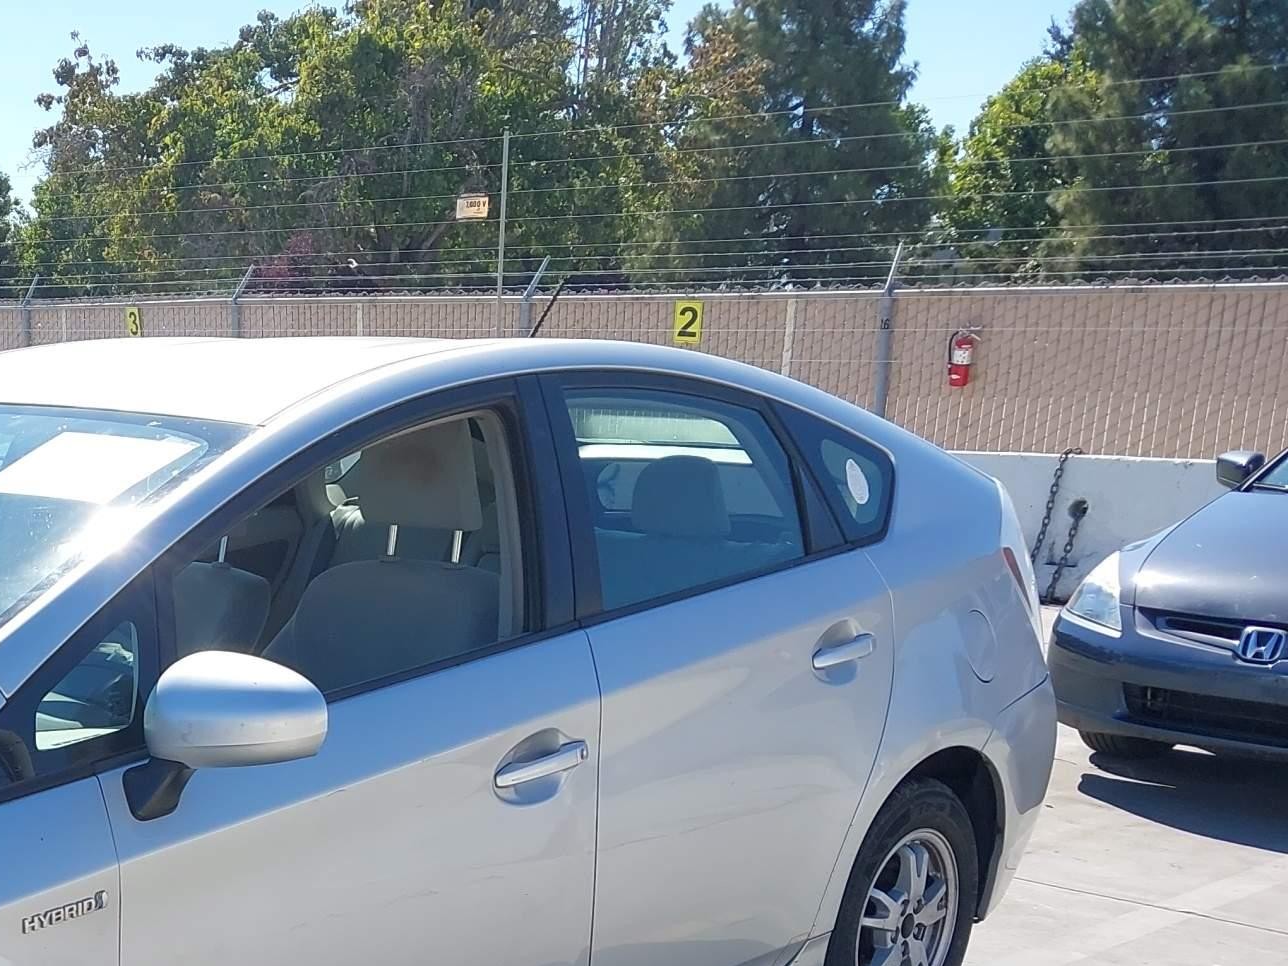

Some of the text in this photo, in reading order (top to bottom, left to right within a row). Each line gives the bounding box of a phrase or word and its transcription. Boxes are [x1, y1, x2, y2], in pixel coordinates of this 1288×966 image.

[128, 311, 139, 336] 3
[677, 306, 698, 338] 2
[22, 897, 96, 934] HYBRID
